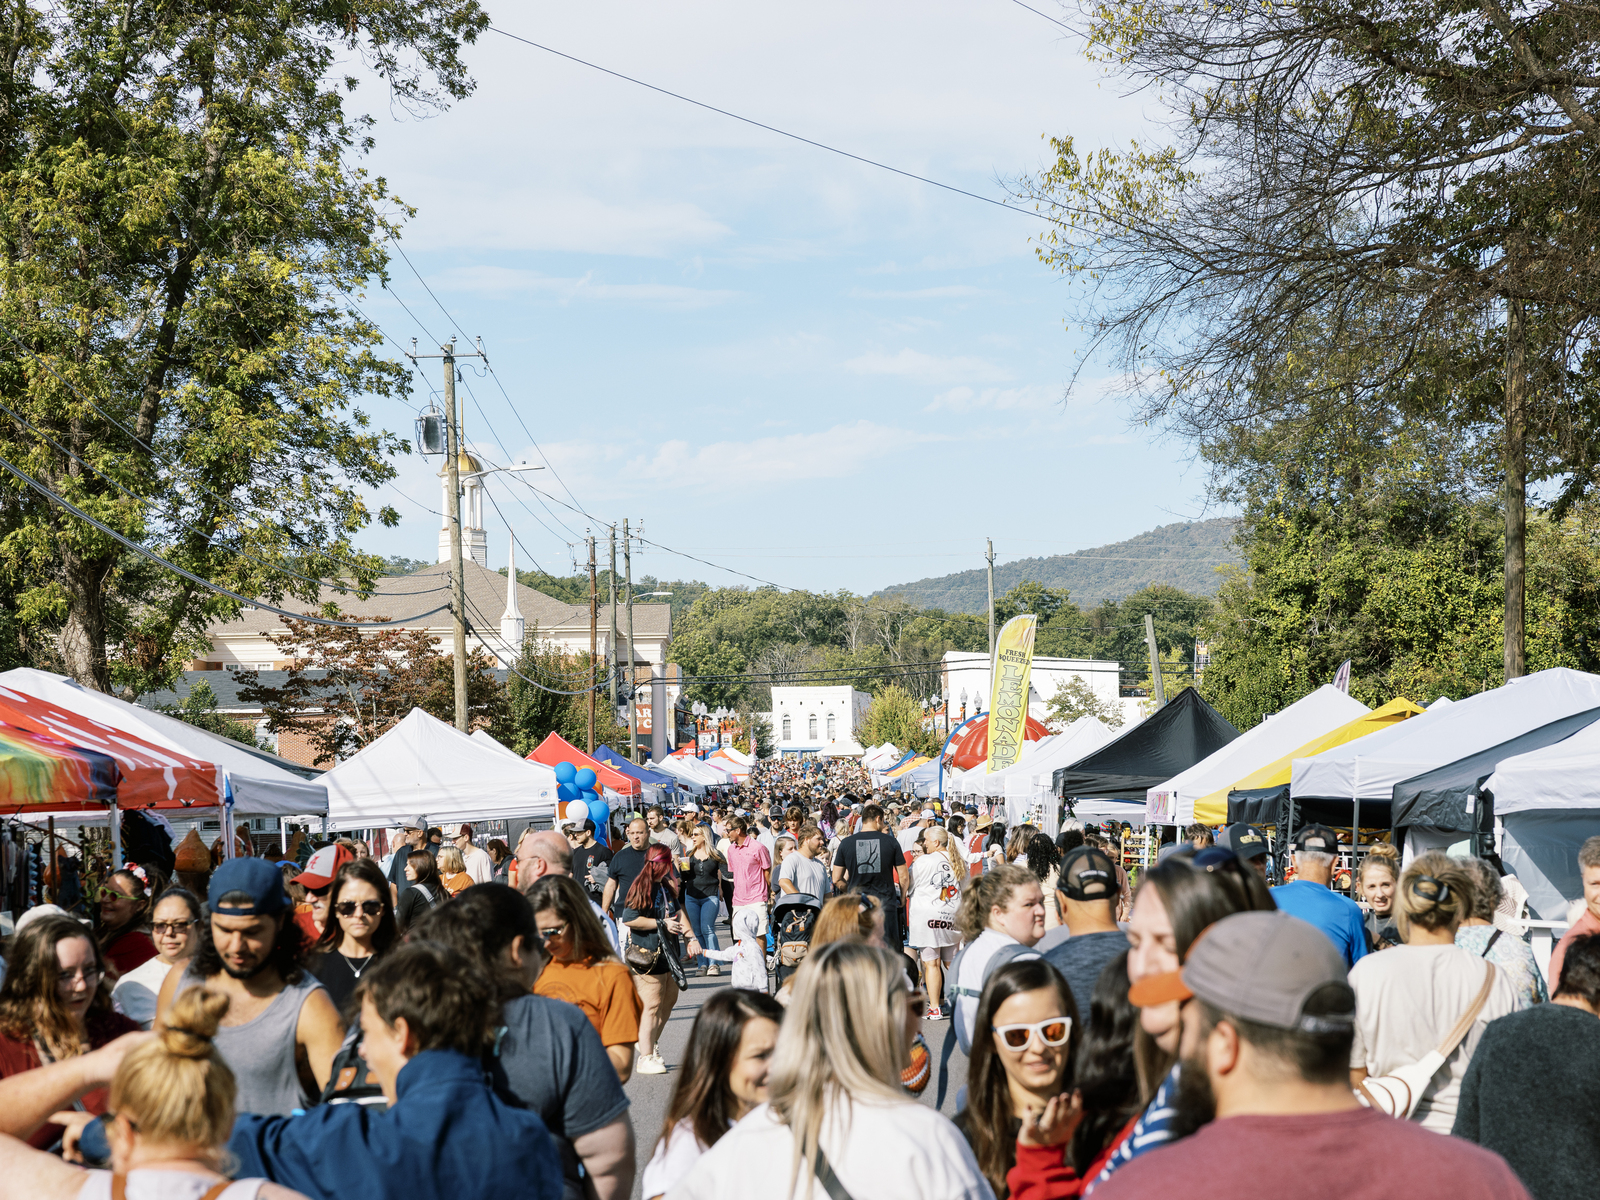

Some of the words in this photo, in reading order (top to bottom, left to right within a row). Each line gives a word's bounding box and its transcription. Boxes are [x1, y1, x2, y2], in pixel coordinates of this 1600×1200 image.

[1005, 649, 1026, 658] FRESH
[999, 654, 1030, 665] SQUEEZED
[991, 664, 1023, 771] LEMONADE
